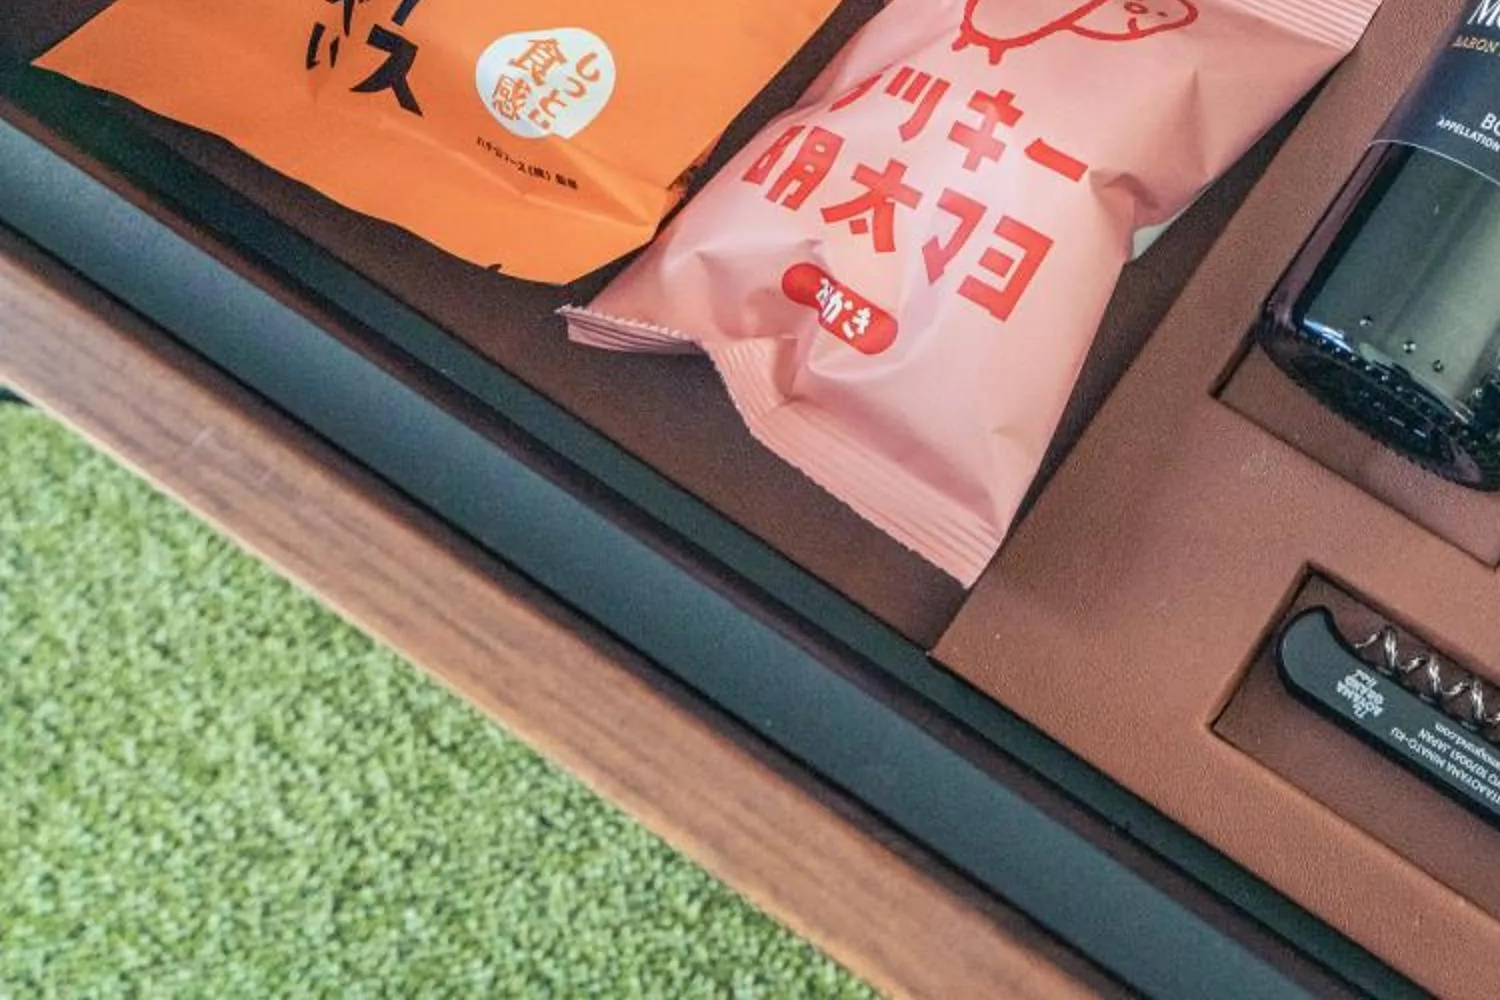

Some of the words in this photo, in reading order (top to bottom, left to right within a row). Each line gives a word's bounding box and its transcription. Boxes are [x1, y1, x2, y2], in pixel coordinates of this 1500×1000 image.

[491, 37, 568, 121] 食感
[828, 64, 1089, 184] ッキー
[741, 124, 1055, 323] 明太マヨ
[1417, 727, 1451, 753] JAPAN
